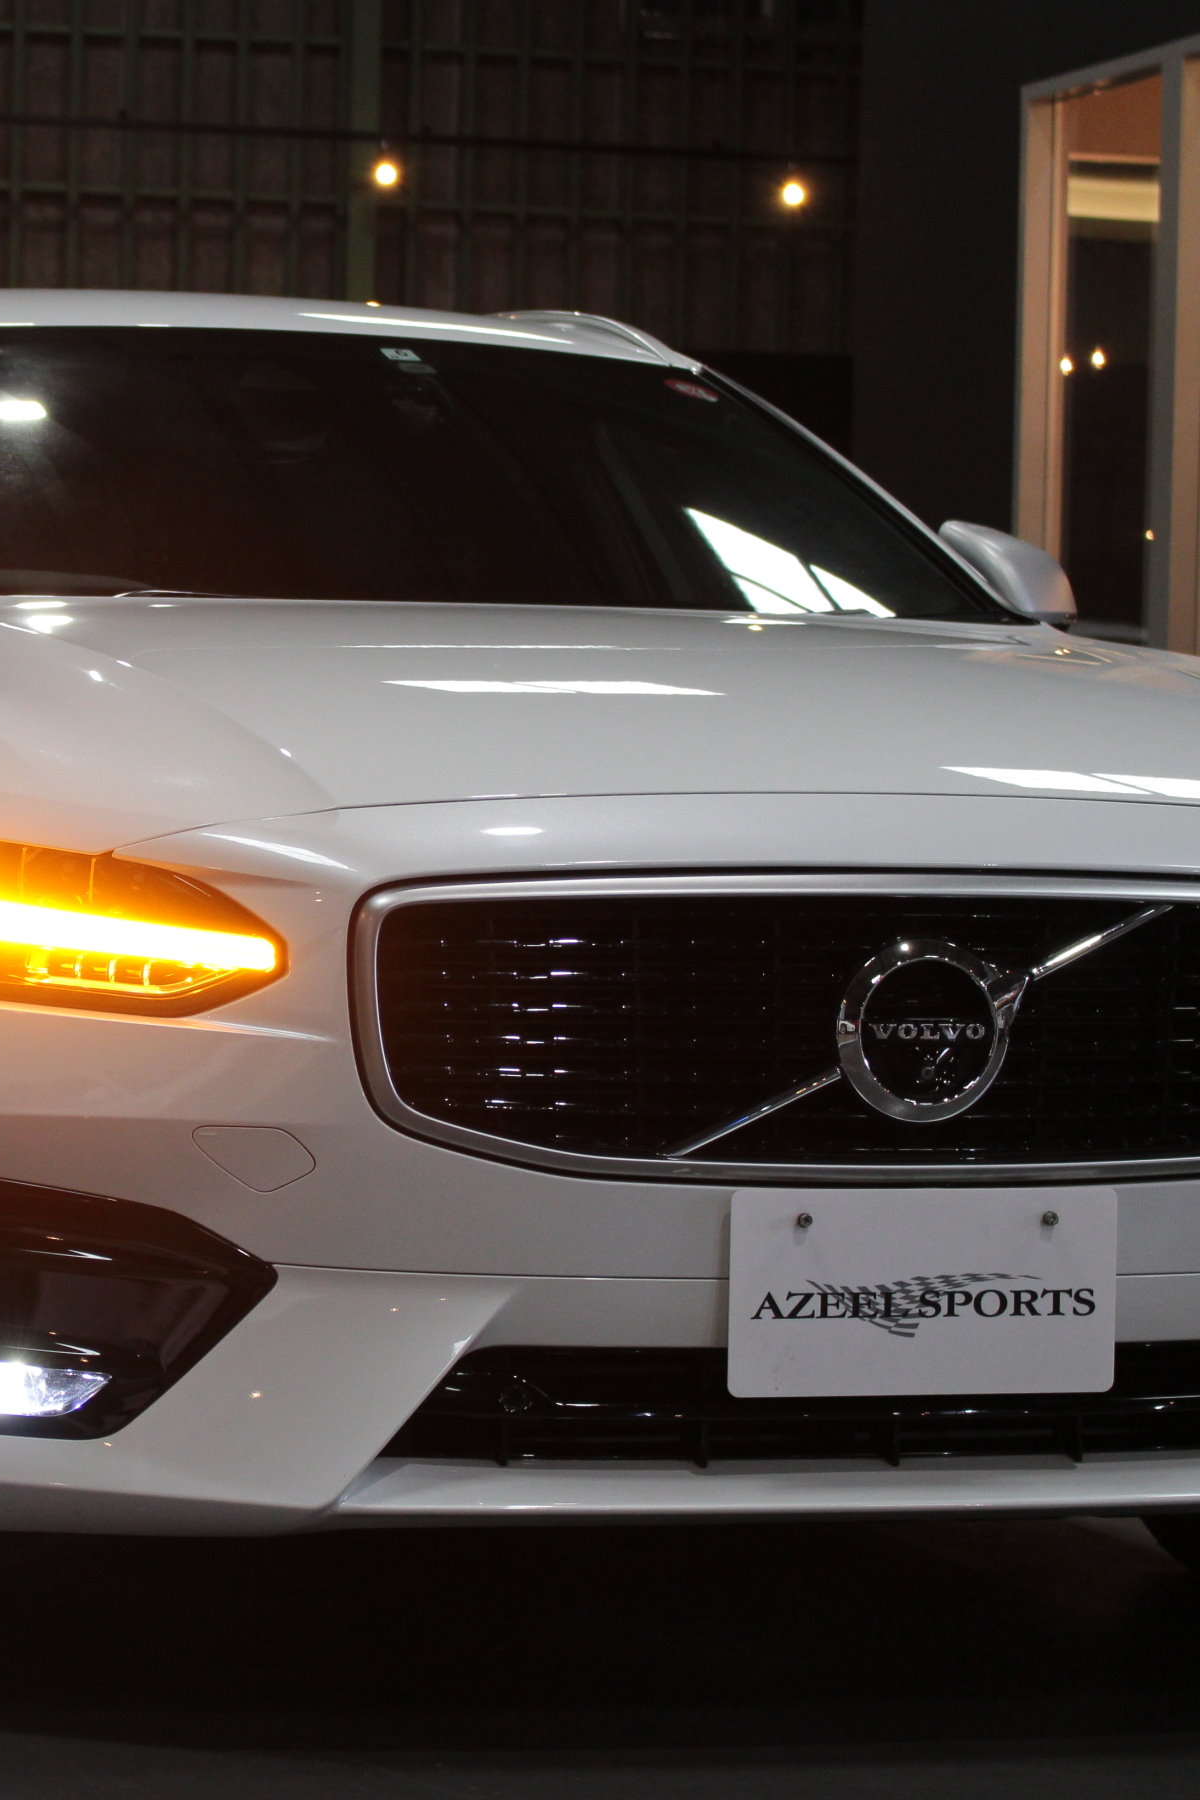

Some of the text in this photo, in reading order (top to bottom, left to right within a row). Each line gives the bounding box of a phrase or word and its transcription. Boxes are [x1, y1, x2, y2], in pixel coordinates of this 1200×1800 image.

[869, 1023, 985, 1040] VOLVO
[750, 1288, 1096, 1320] AZEEL SPORTS
